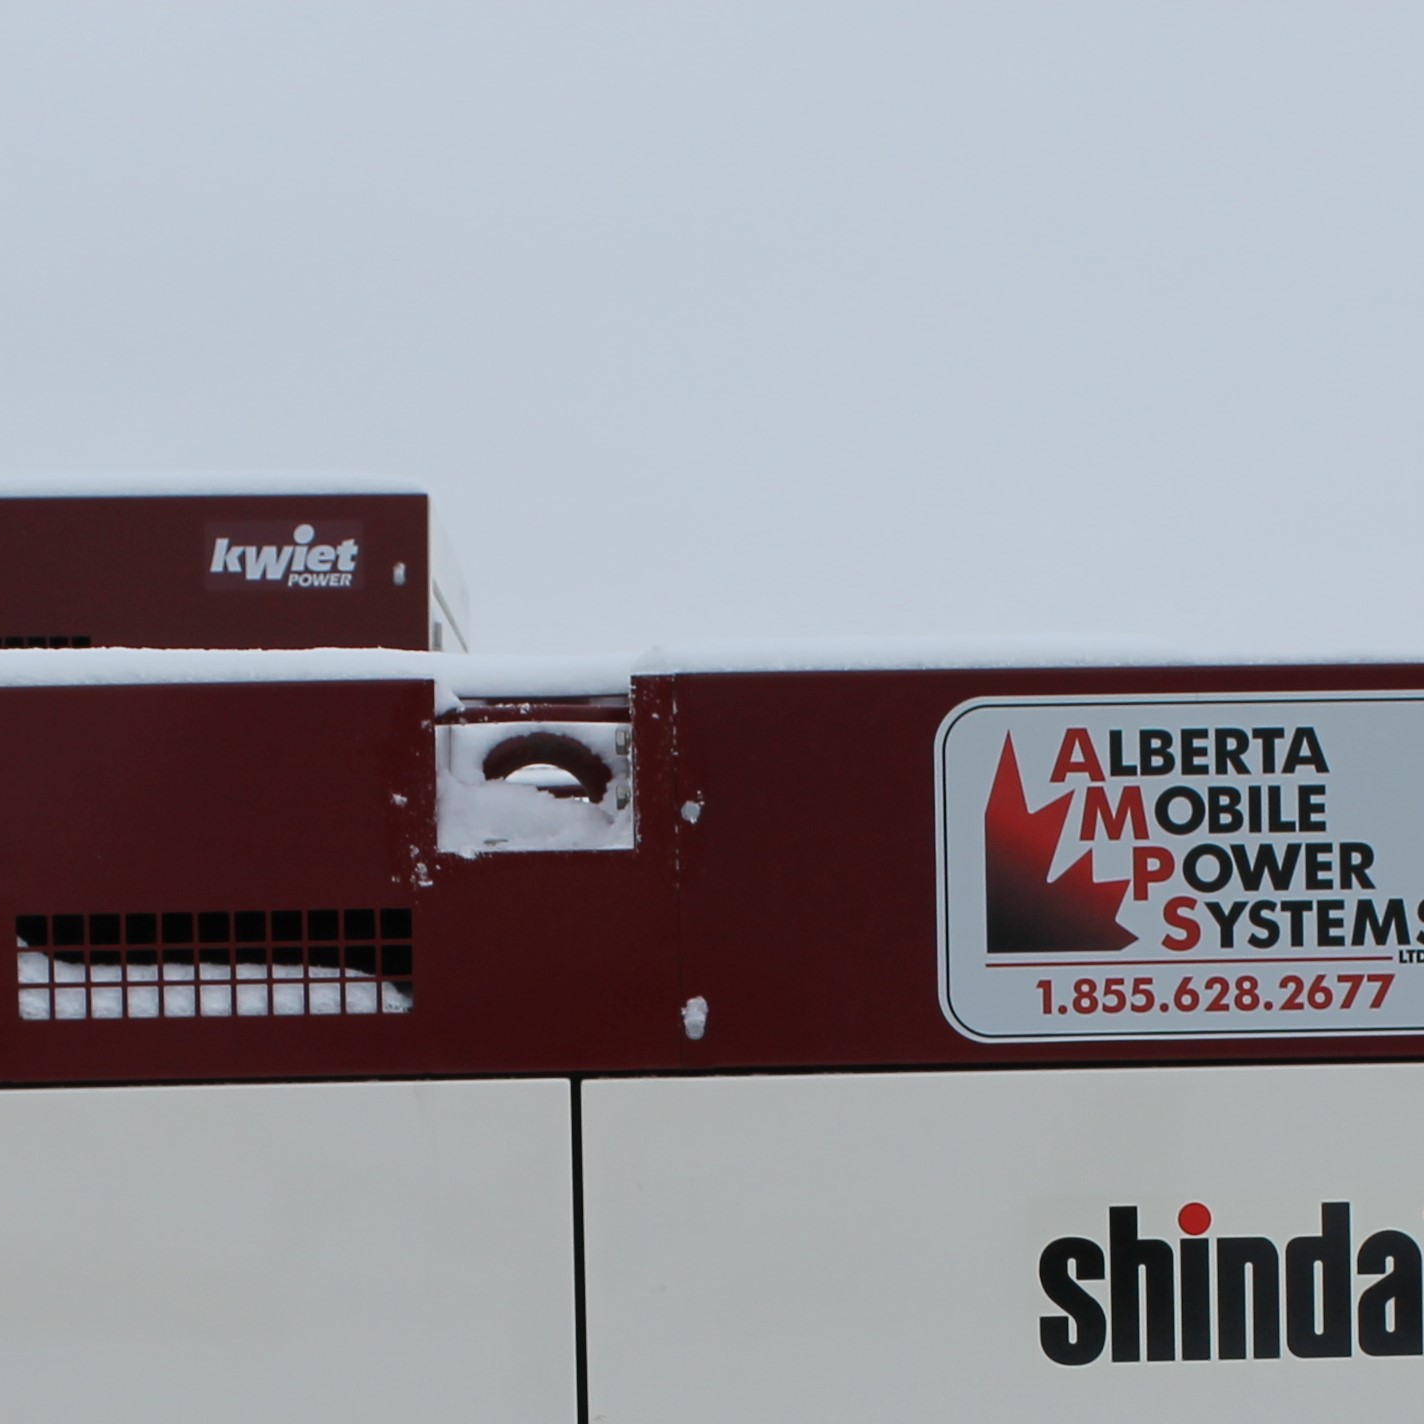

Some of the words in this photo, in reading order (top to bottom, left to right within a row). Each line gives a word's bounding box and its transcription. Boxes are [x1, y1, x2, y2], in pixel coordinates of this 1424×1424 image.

[209, 523, 359, 580] kwiet
[287, 573, 352, 588] POWER
[1049, 726, 1330, 784] ALBERTA
[1079, 784, 1327, 841] MOBILE
[1132, 841, 1377, 901] POWER
[1034, 973, 1396, 1016] 1.855.628.2677
